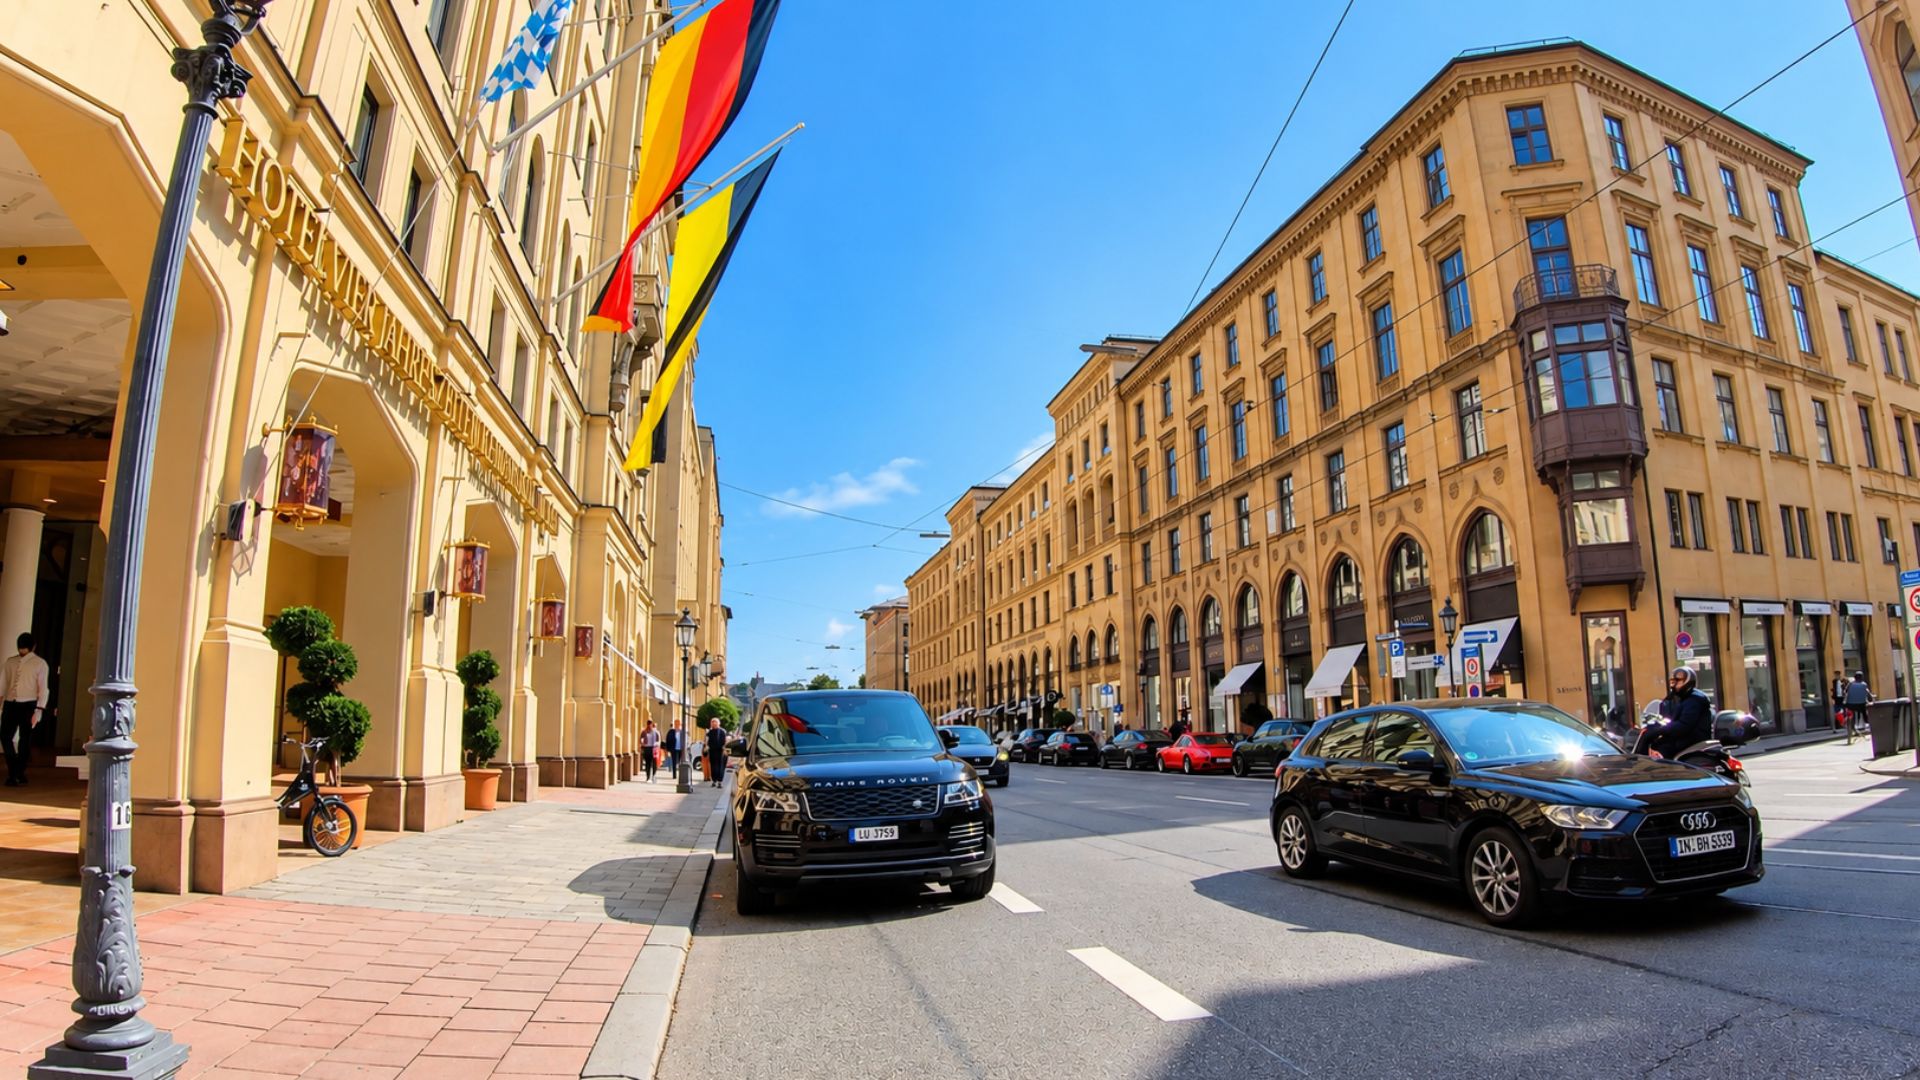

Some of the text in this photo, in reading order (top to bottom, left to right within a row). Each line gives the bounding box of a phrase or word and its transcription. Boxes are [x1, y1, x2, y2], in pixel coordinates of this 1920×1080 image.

[217, 117, 327, 278] HOTEL
[330, 240, 379, 337] VIER
[1391, 643, 1400, 656] P
[814, 776, 929, 788] RANGE ROVER
[858, 829, 870, 840] LU
